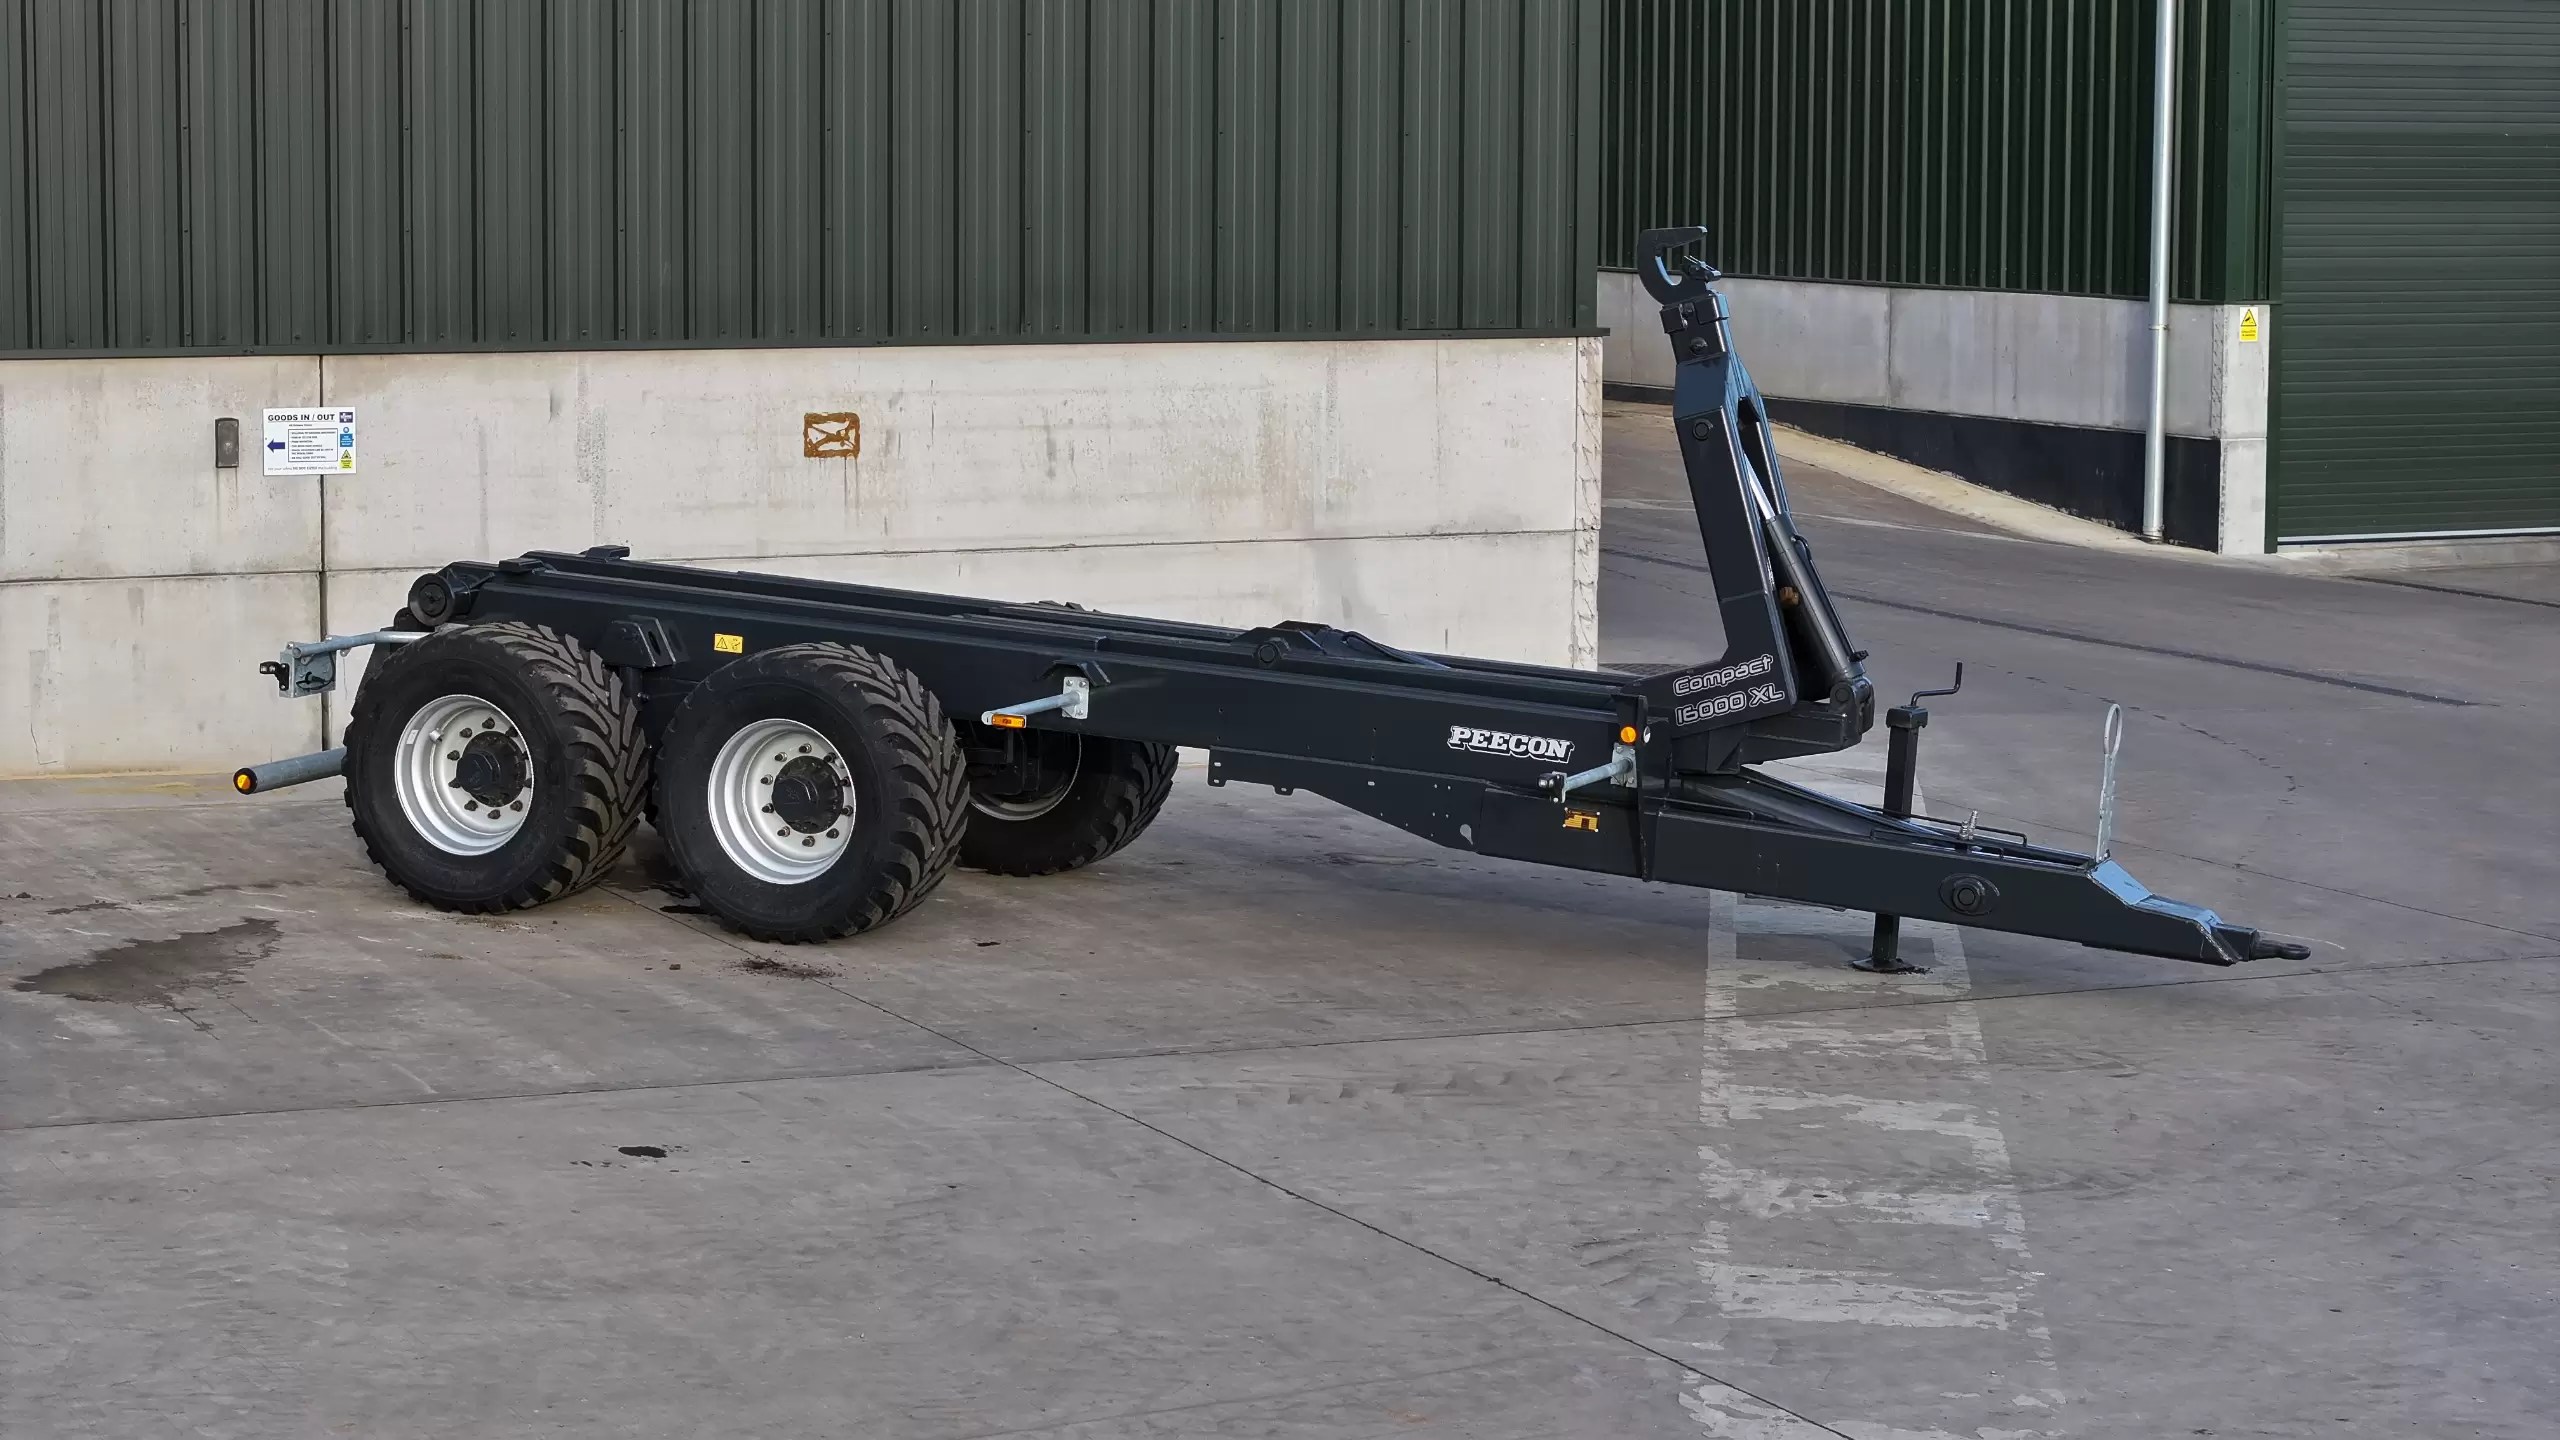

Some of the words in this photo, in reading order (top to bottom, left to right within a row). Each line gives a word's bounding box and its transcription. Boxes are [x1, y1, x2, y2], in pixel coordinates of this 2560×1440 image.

[1673, 654, 1774, 696] Compact
[1675, 690, 1746, 726] 16000
[1749, 683, 1784, 707] XL
[1448, 725, 1574, 763] PEECON
